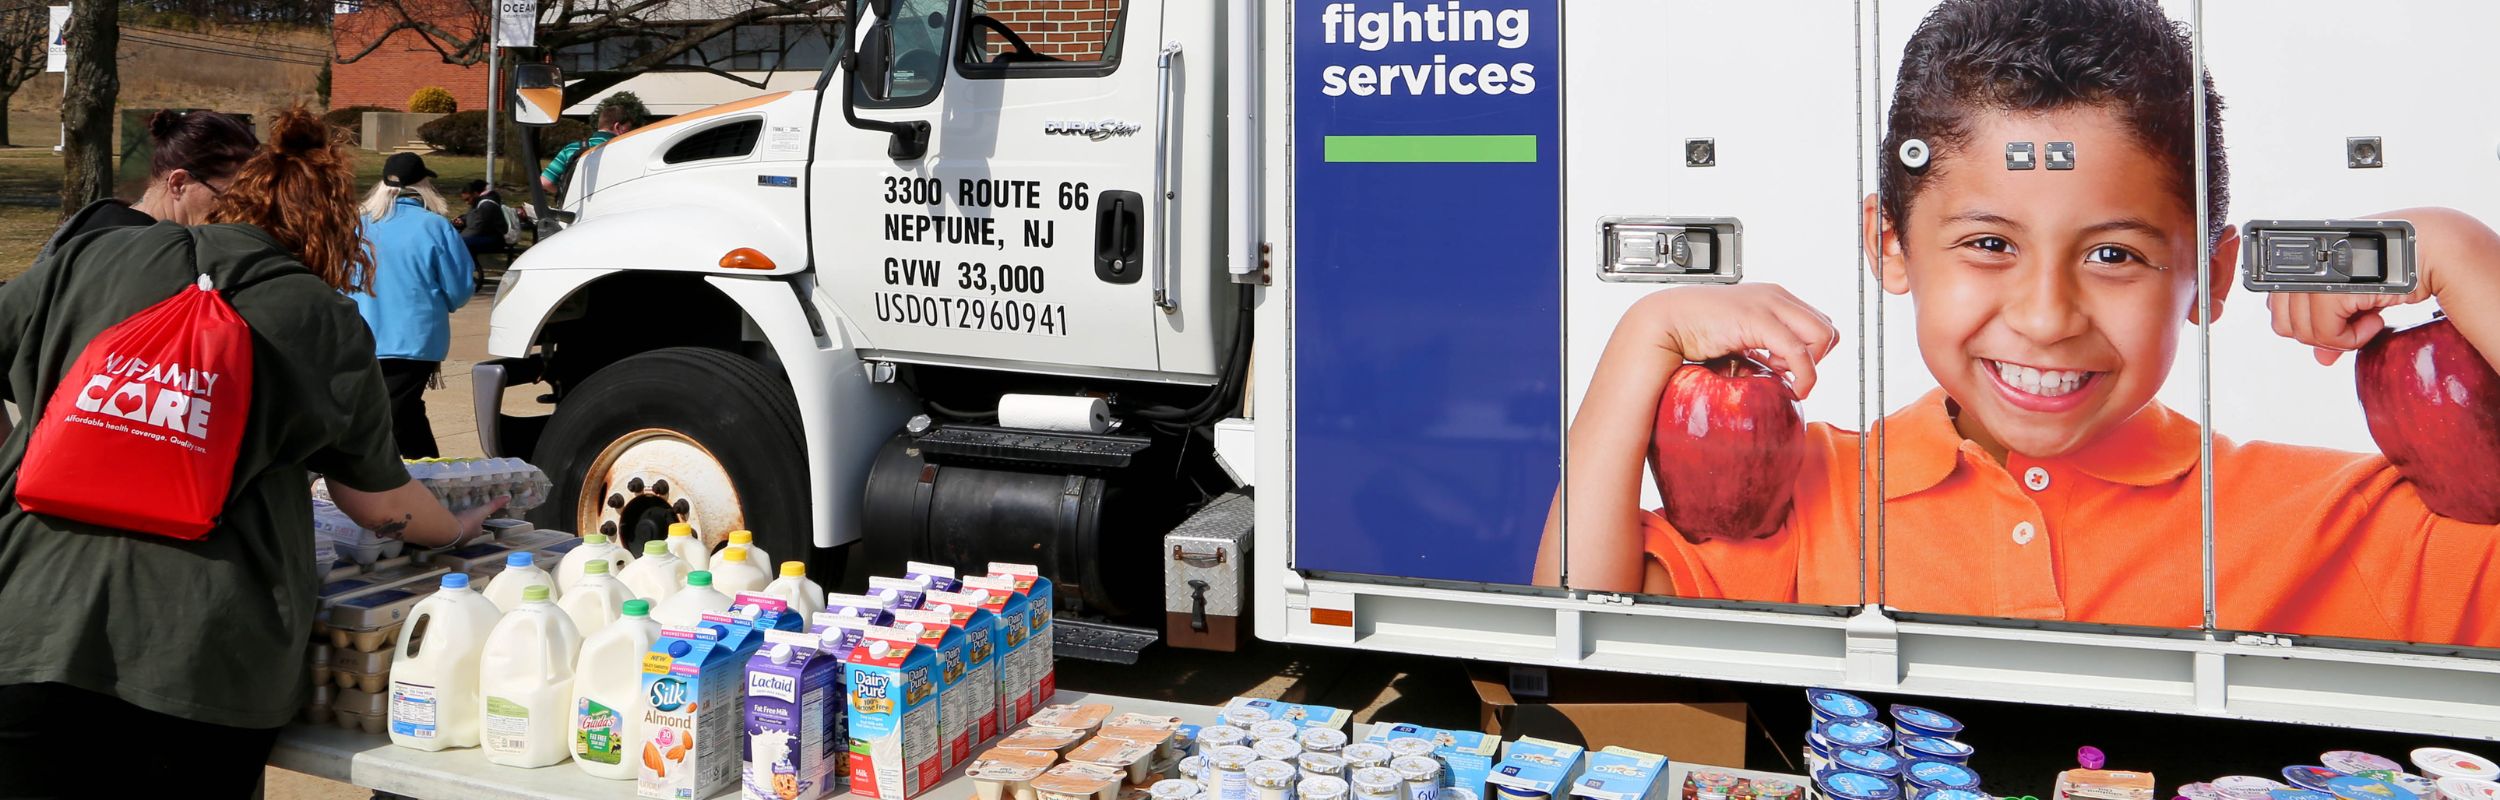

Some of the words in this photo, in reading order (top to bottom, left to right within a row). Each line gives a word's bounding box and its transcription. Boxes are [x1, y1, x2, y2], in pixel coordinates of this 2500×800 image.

[503, 3, 536, 13] OCEAN
[1322, 0, 1530, 51] fighting
[1322, 54, 1536, 96] services
[884, 176, 942, 206] 3300
[958, 178, 1041, 209] ROUTE
[1058, 181, 1089, 211] 66
[884, 213, 1005, 251] NEPTUNE,
[1023, 219, 1054, 249] NJ
[884, 257, 941, 288] GVW
[957, 262, 1045, 296] 33,000
[874, 291, 1067, 336] USDOT2960941
[75, 374, 212, 440] CARE
[64, 414, 104, 428] Affordable
[105, 421, 129, 433] health
[131, 428, 167, 442] coverage.
[170, 435, 194, 450] Quality
[1032, 596, 1047, 610] Dairy
[1033, 604, 1047, 618] Pure
[1007, 611, 1024, 626] Dairy
[970, 627, 988, 643] Dairy
[1009, 619, 1024, 635] Pure
[972, 636, 988, 650] Pure
[944, 646, 961, 661] Dairy
[945, 655, 961, 669] Pure
[855, 669, 890, 688] Dairy
[908, 666, 929, 681] Dairy
[751, 674, 793, 693] Lactaid
[857, 682, 887, 698] Pure
[910, 675, 927, 693] Pure
[650, 681, 687, 708] Silk
[754, 704, 764, 713] Fat
[763, 705, 776, 715] Free
[776, 707, 788, 717] Milk
[582, 714, 615, 729] Guida's
[644, 709, 692, 730] Almond
[662, 731, 672, 739] 30
[1511, 753, 1562, 767] OIKOS
[855, 768, 868, 777] Milk
[1593, 765, 1648, 778] OIKOS
